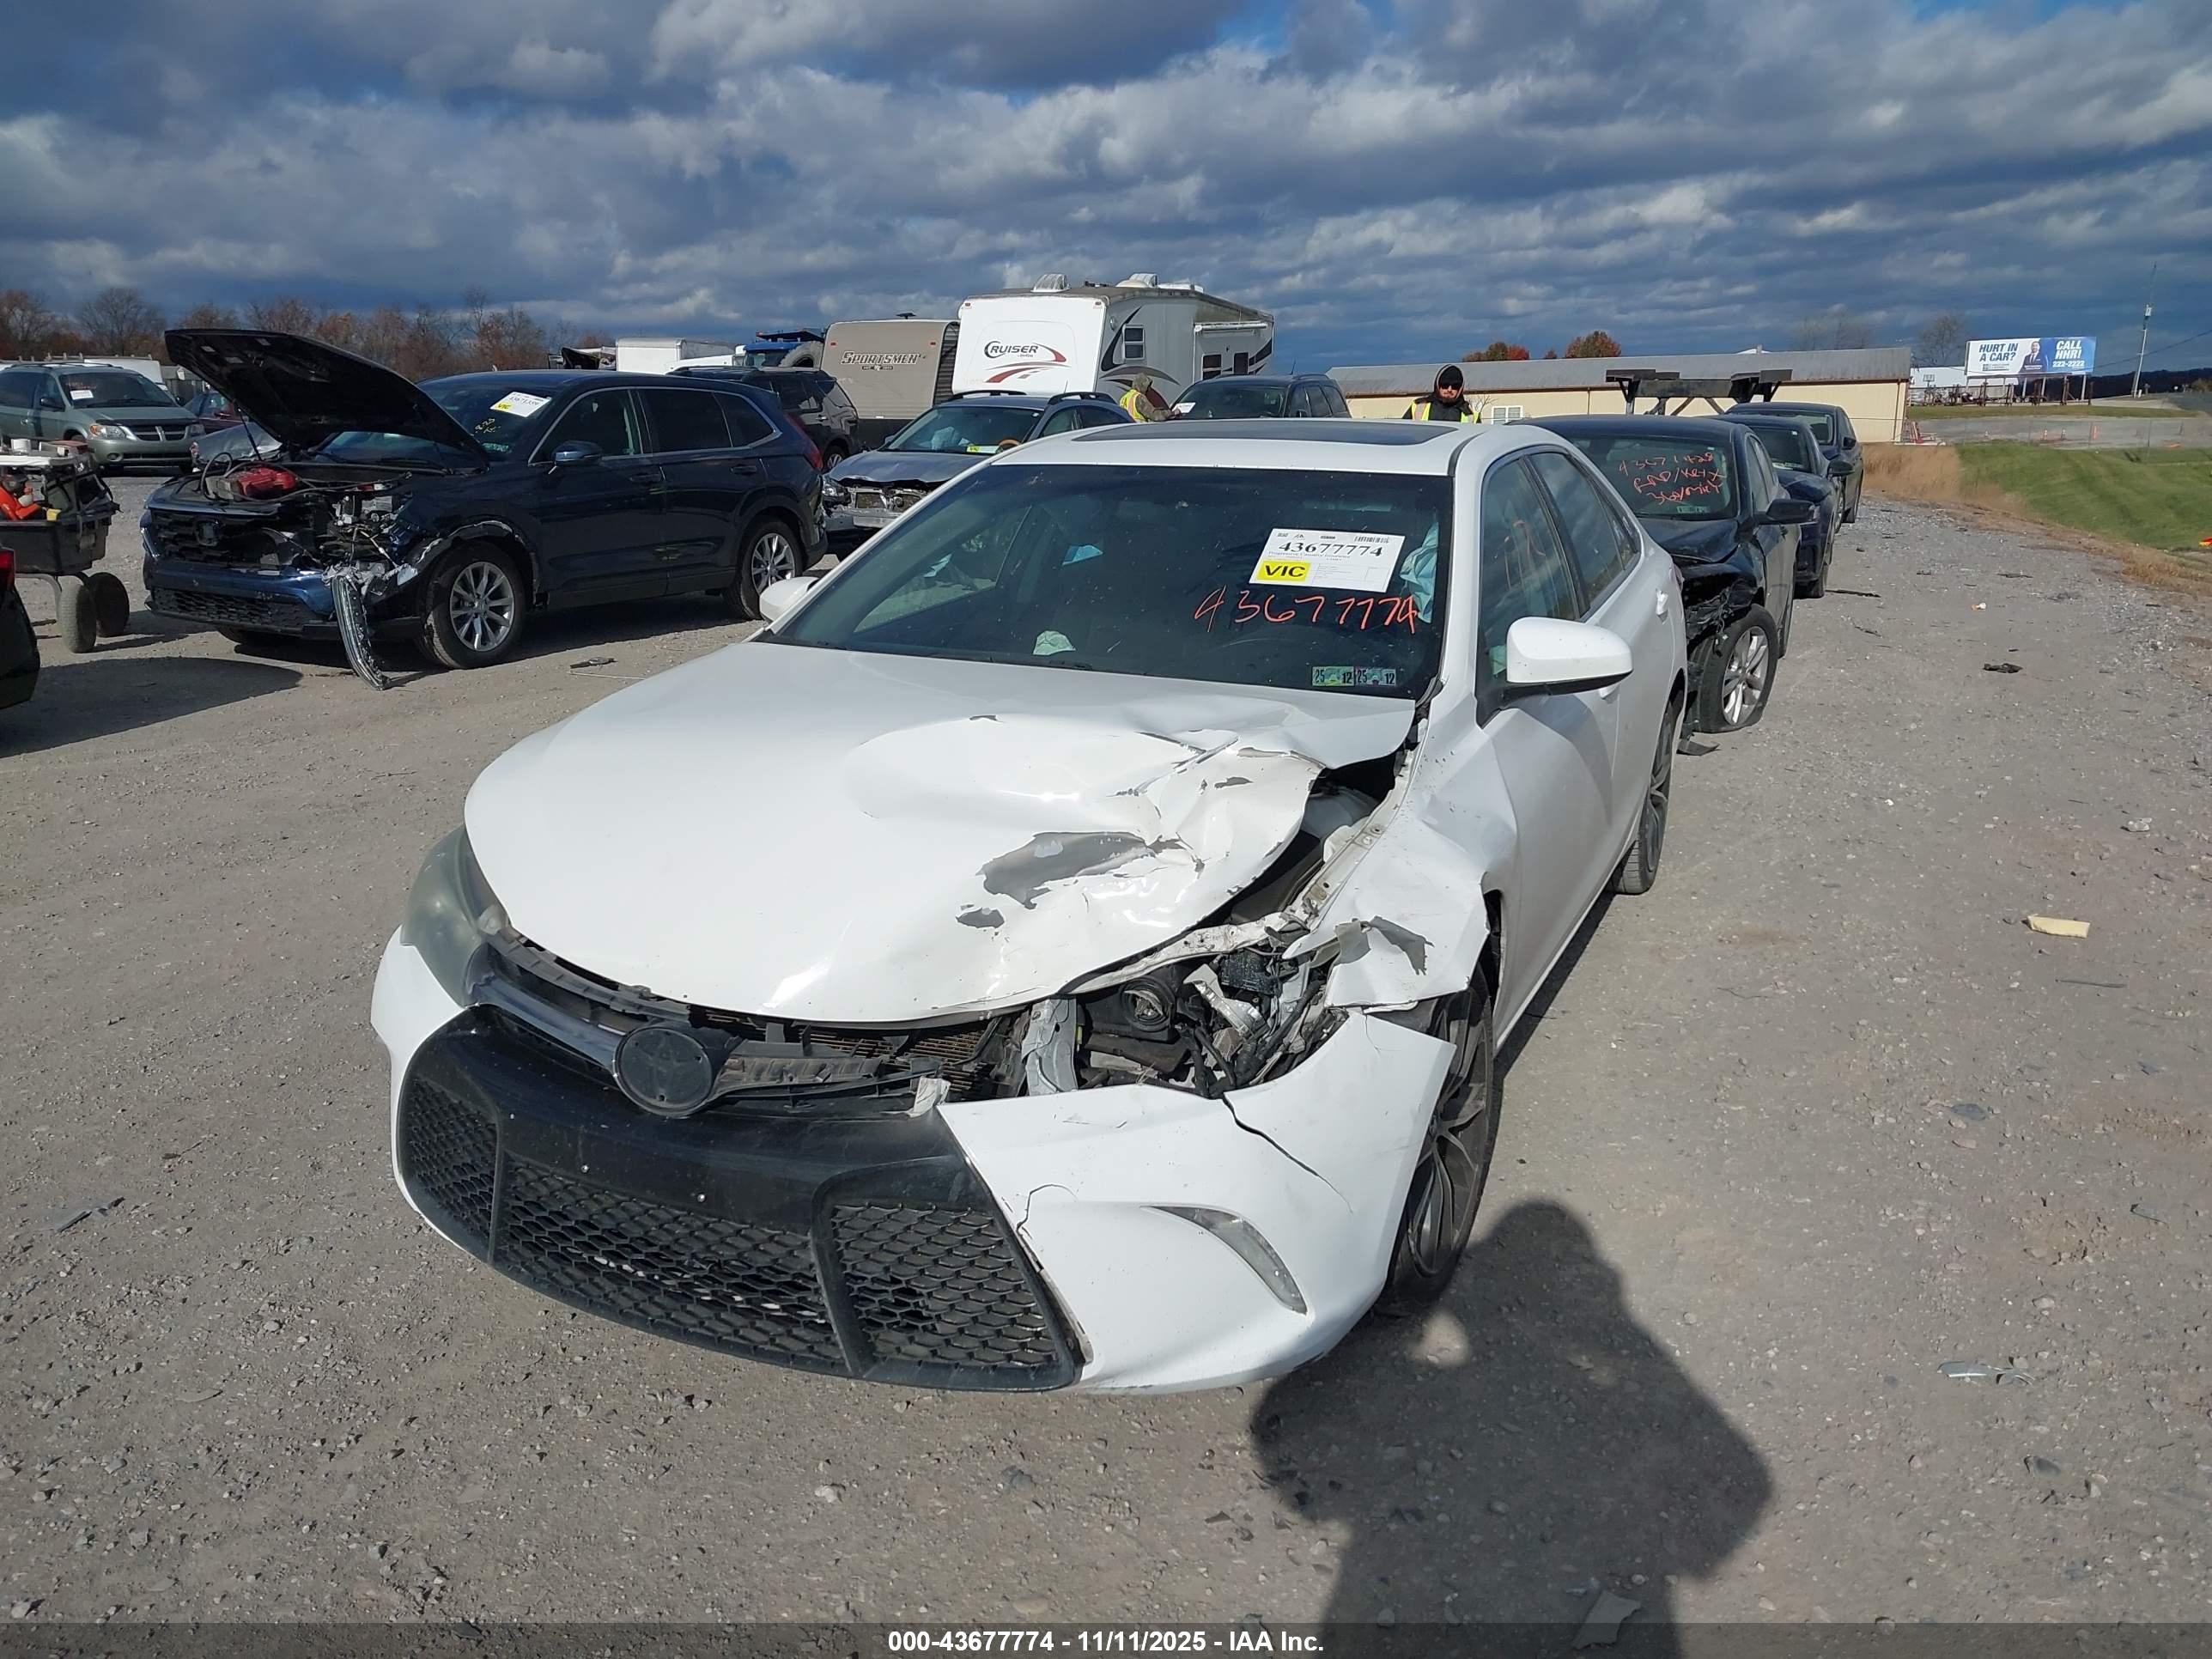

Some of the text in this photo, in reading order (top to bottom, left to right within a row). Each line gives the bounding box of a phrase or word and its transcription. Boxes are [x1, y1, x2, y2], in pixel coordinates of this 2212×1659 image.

[984, 341, 1039, 358] CRUISER
[1979, 343, 2019, 353] HURT IN
[2057, 340, 2081, 349] CALL
[1979, 352, 2016, 362] A CAR?
[1279, 541, 1382, 557] 43677774
[1265, 565, 1306, 578] VIC
[1316, 670, 1352, 684] 25 12
[1358, 670, 1395, 684] 25 12
